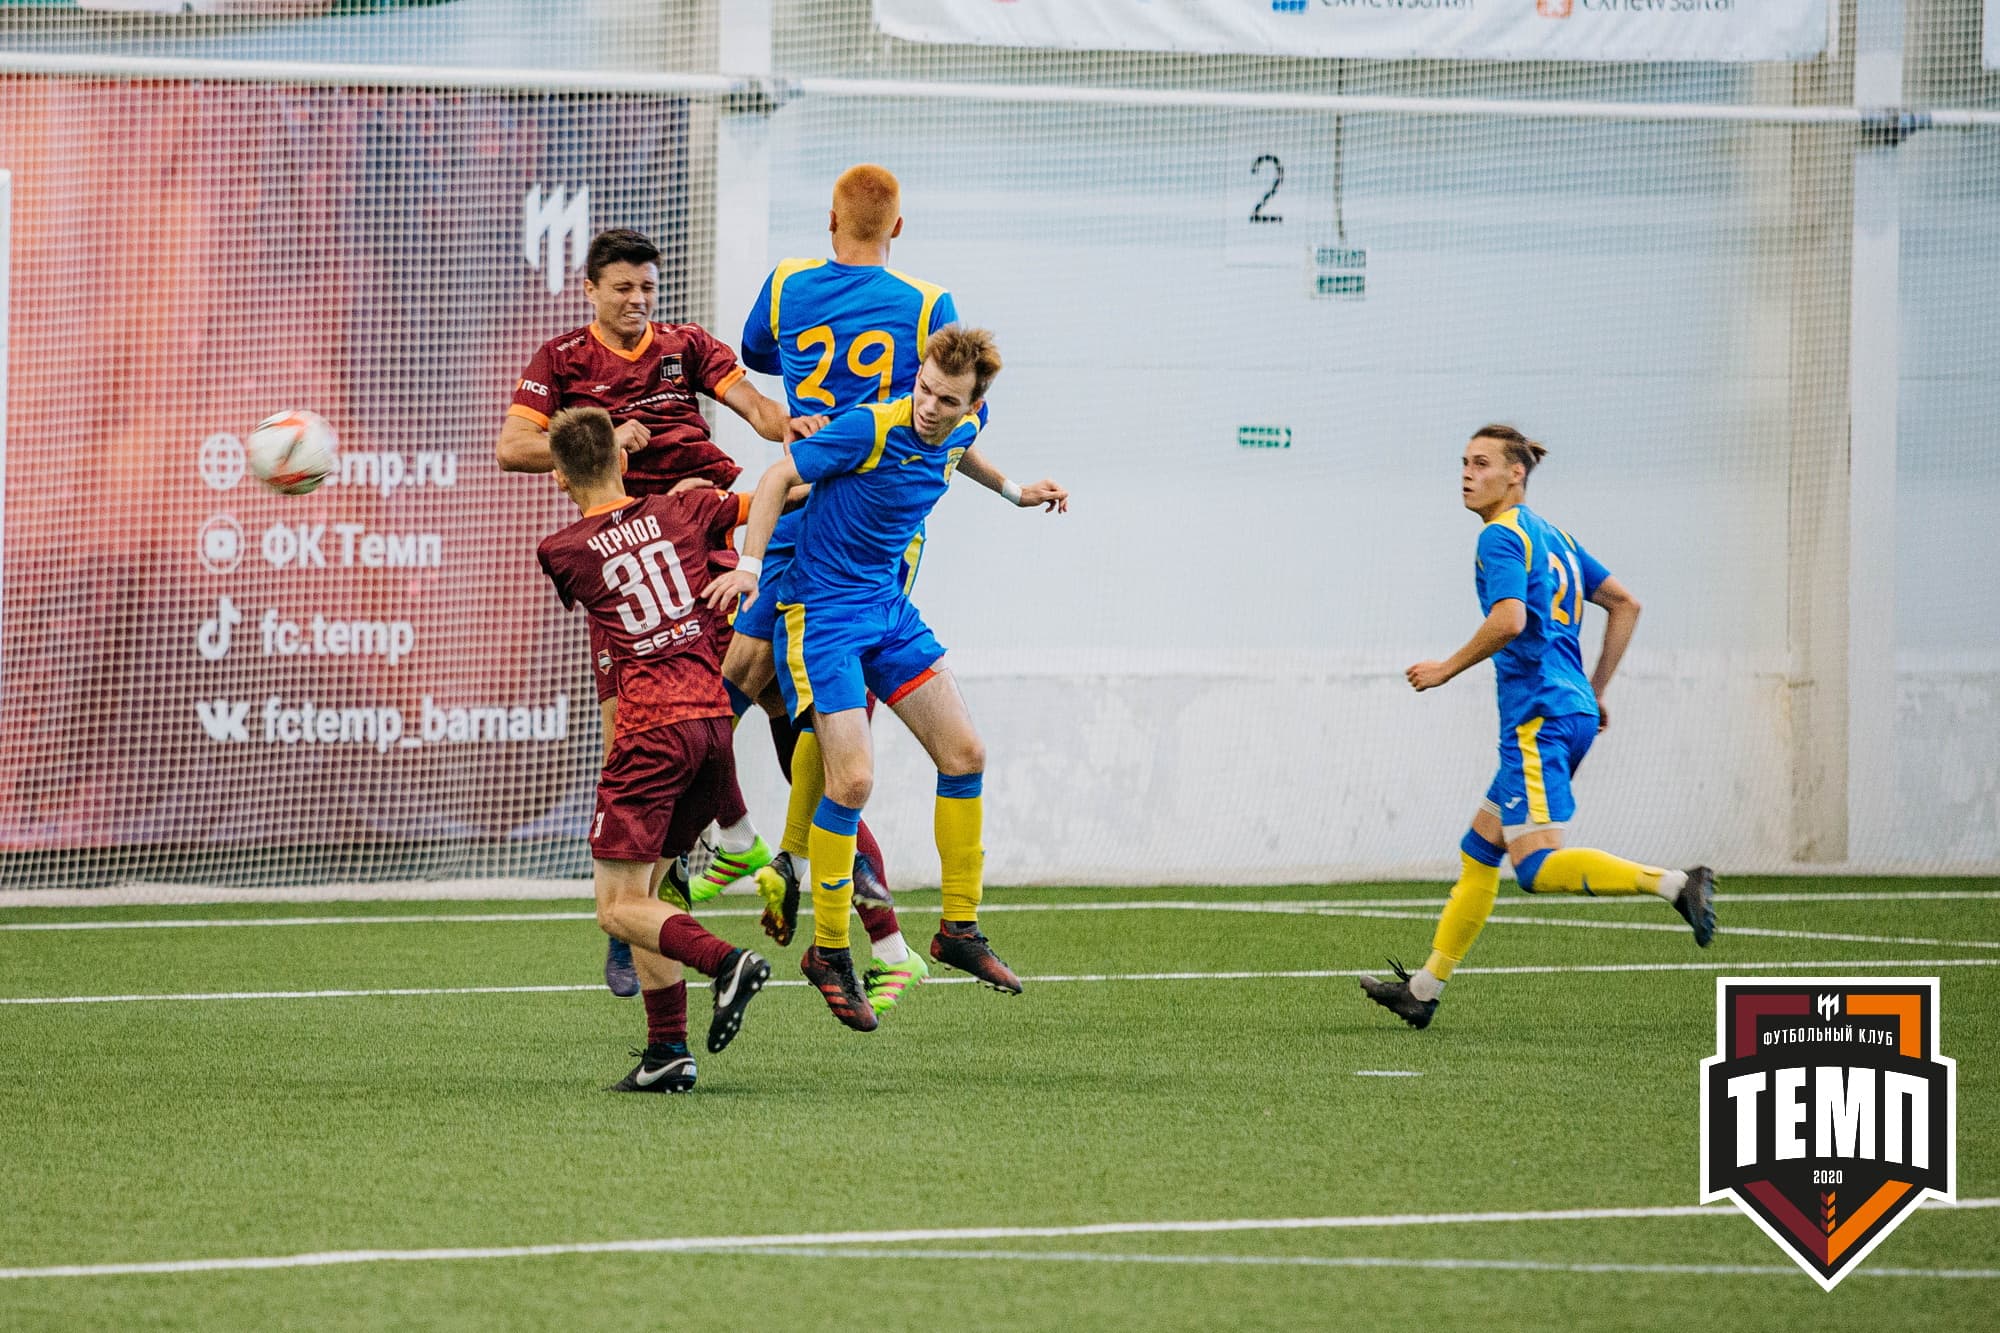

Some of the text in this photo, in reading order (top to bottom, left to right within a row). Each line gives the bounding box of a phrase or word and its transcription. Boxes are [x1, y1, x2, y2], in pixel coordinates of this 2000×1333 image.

[1250, 154, 1284, 223] 2
[521, 379, 549, 397] ПСБ
[795, 325, 895, 408] 29
[324, 452, 458, 497] emp.ru
[261, 522, 443, 568] ФК Темп
[586, 514, 662, 558] ЧЕРНОВ
[601, 539, 696, 635] 30
[1548, 550, 1584, 625] 21
[259, 608, 415, 665] fc.temp
[262, 695, 569, 753] fctemp_barnaul
